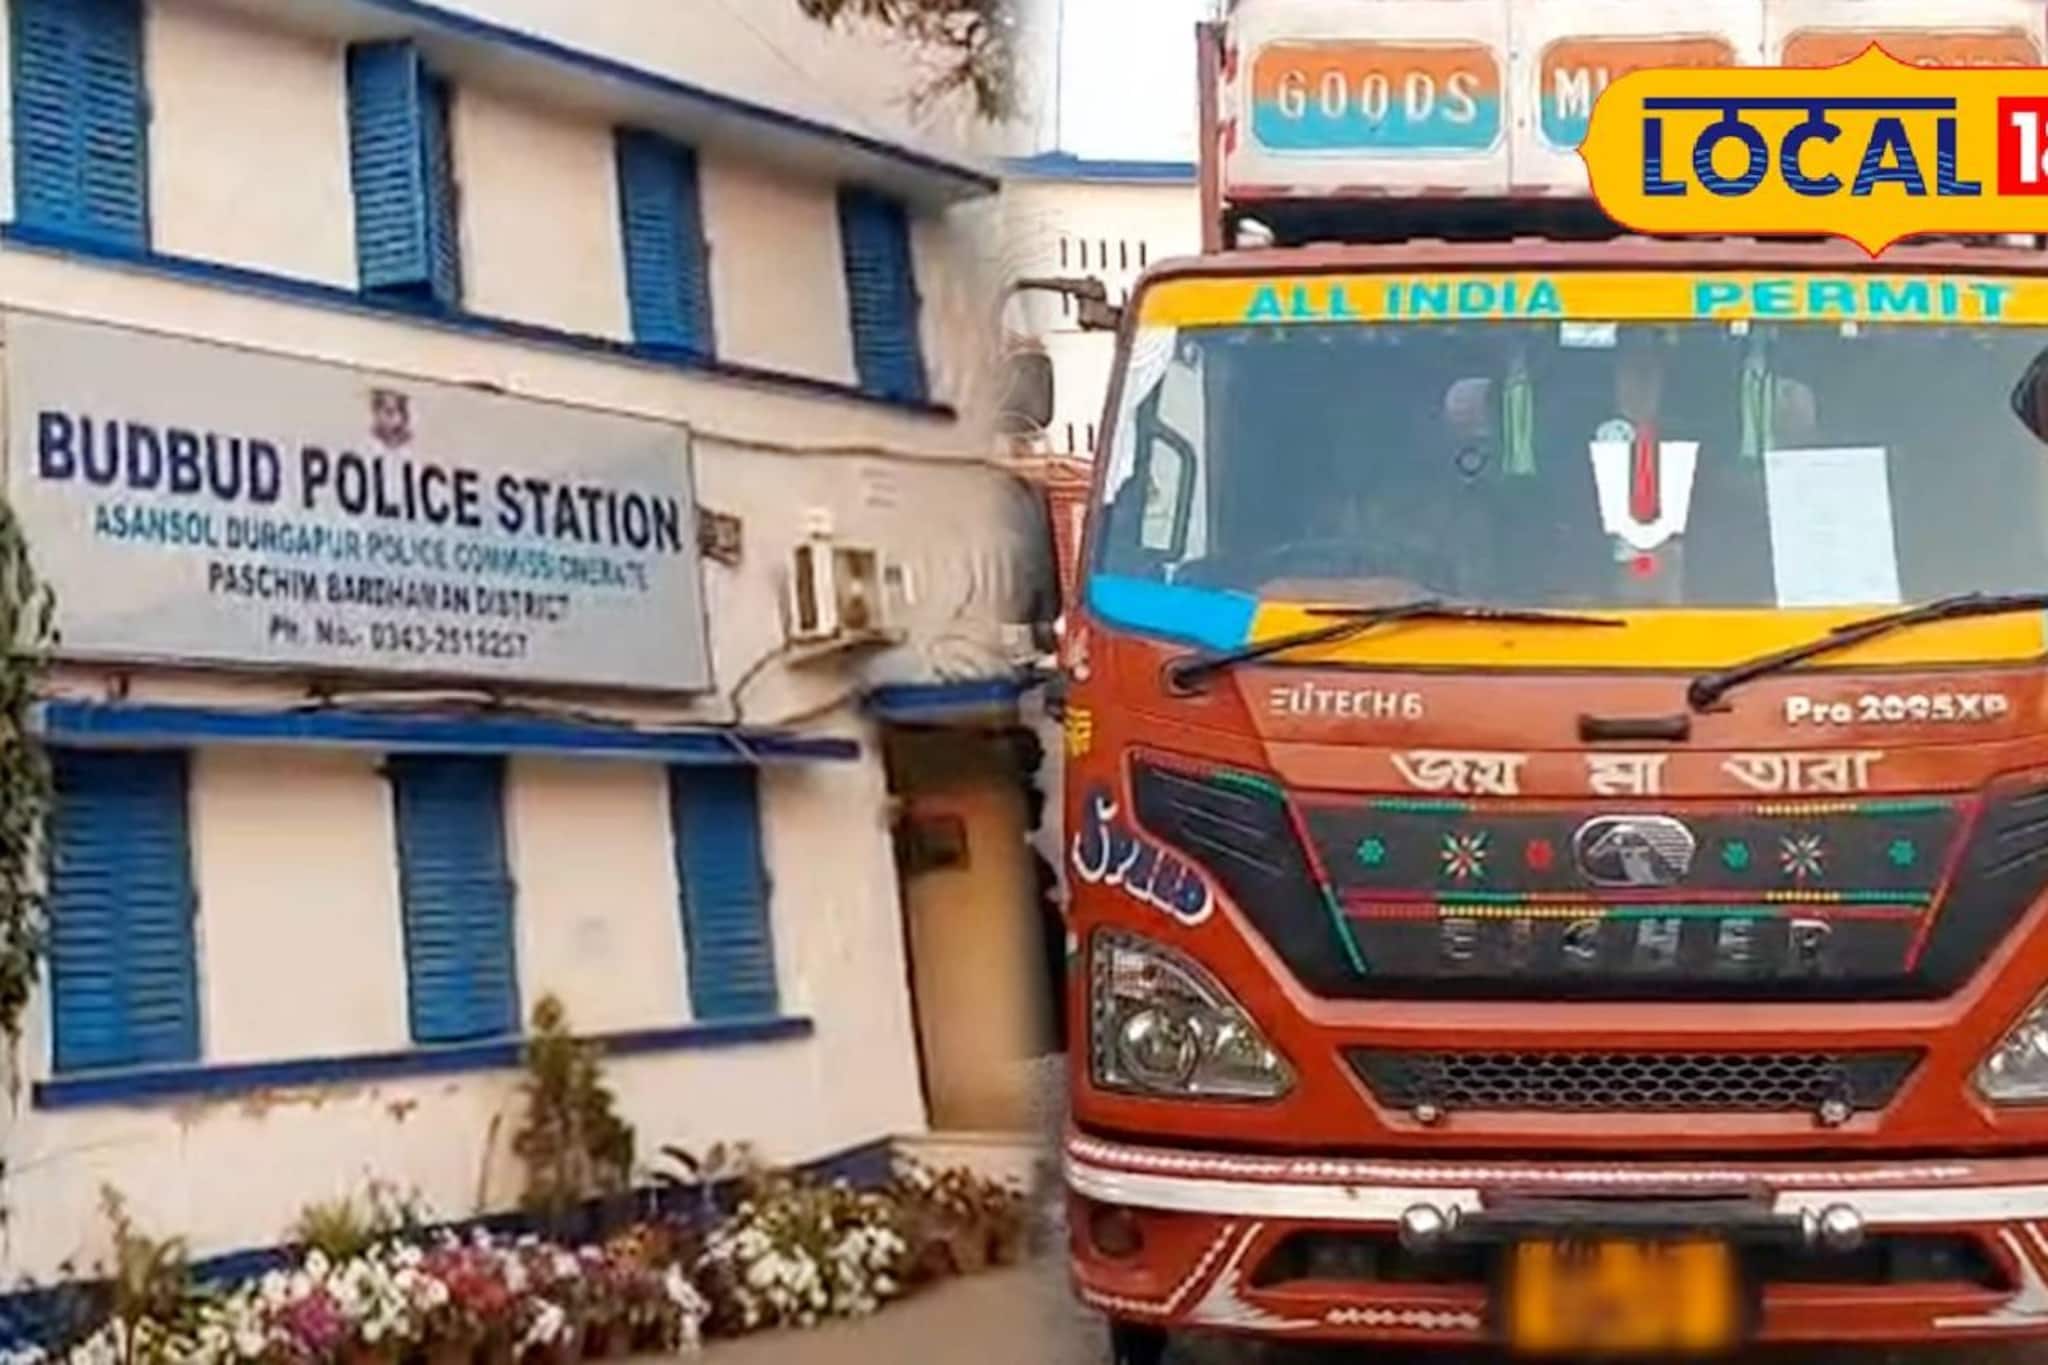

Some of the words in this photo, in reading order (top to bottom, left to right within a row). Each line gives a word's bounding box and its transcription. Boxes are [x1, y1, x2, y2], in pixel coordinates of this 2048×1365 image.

[1277, 69, 1479, 124] GOODS
[1246, 280, 1357, 320] ALL
[1384, 277, 1562, 317] INDIA
[1694, 278, 2011, 317] PERMIT
[38, 410, 280, 503] BUDBUD
[302, 447, 481, 527] POLICE
[496, 474, 682, 553] STATION
[95, 503, 219, 547] ASANSOL
[226, 514, 361, 560] DURGAPUR
[367, 530, 449, 571] POLICE
[454, 543, 648, 591] COMMISSONERATE
[208, 561, 320, 601] PASCHIM
[1786, 696, 1852, 724] Pro
[1390, 753, 1528, 795] জয়
[1722, 751, 1884, 791] তারা
